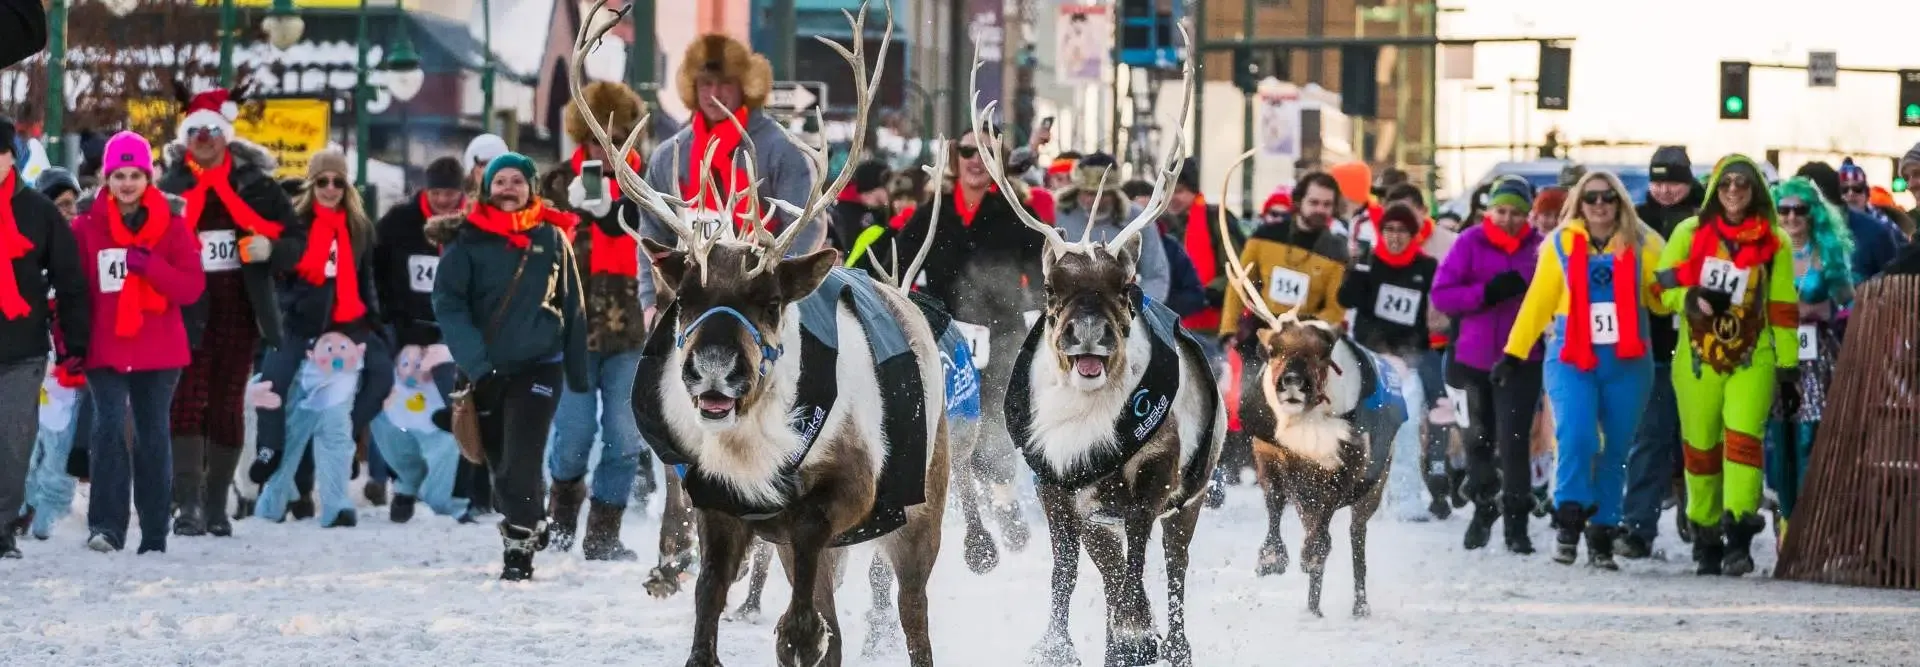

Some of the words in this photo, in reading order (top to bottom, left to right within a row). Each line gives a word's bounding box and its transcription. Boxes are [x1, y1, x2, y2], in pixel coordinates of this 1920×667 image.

[208, 241, 236, 260] 307
[1708, 269, 1740, 294] 514
[1383, 294, 1412, 315] 243
[1595, 314, 1613, 332] 51
[1133, 394, 1168, 438] alaska
